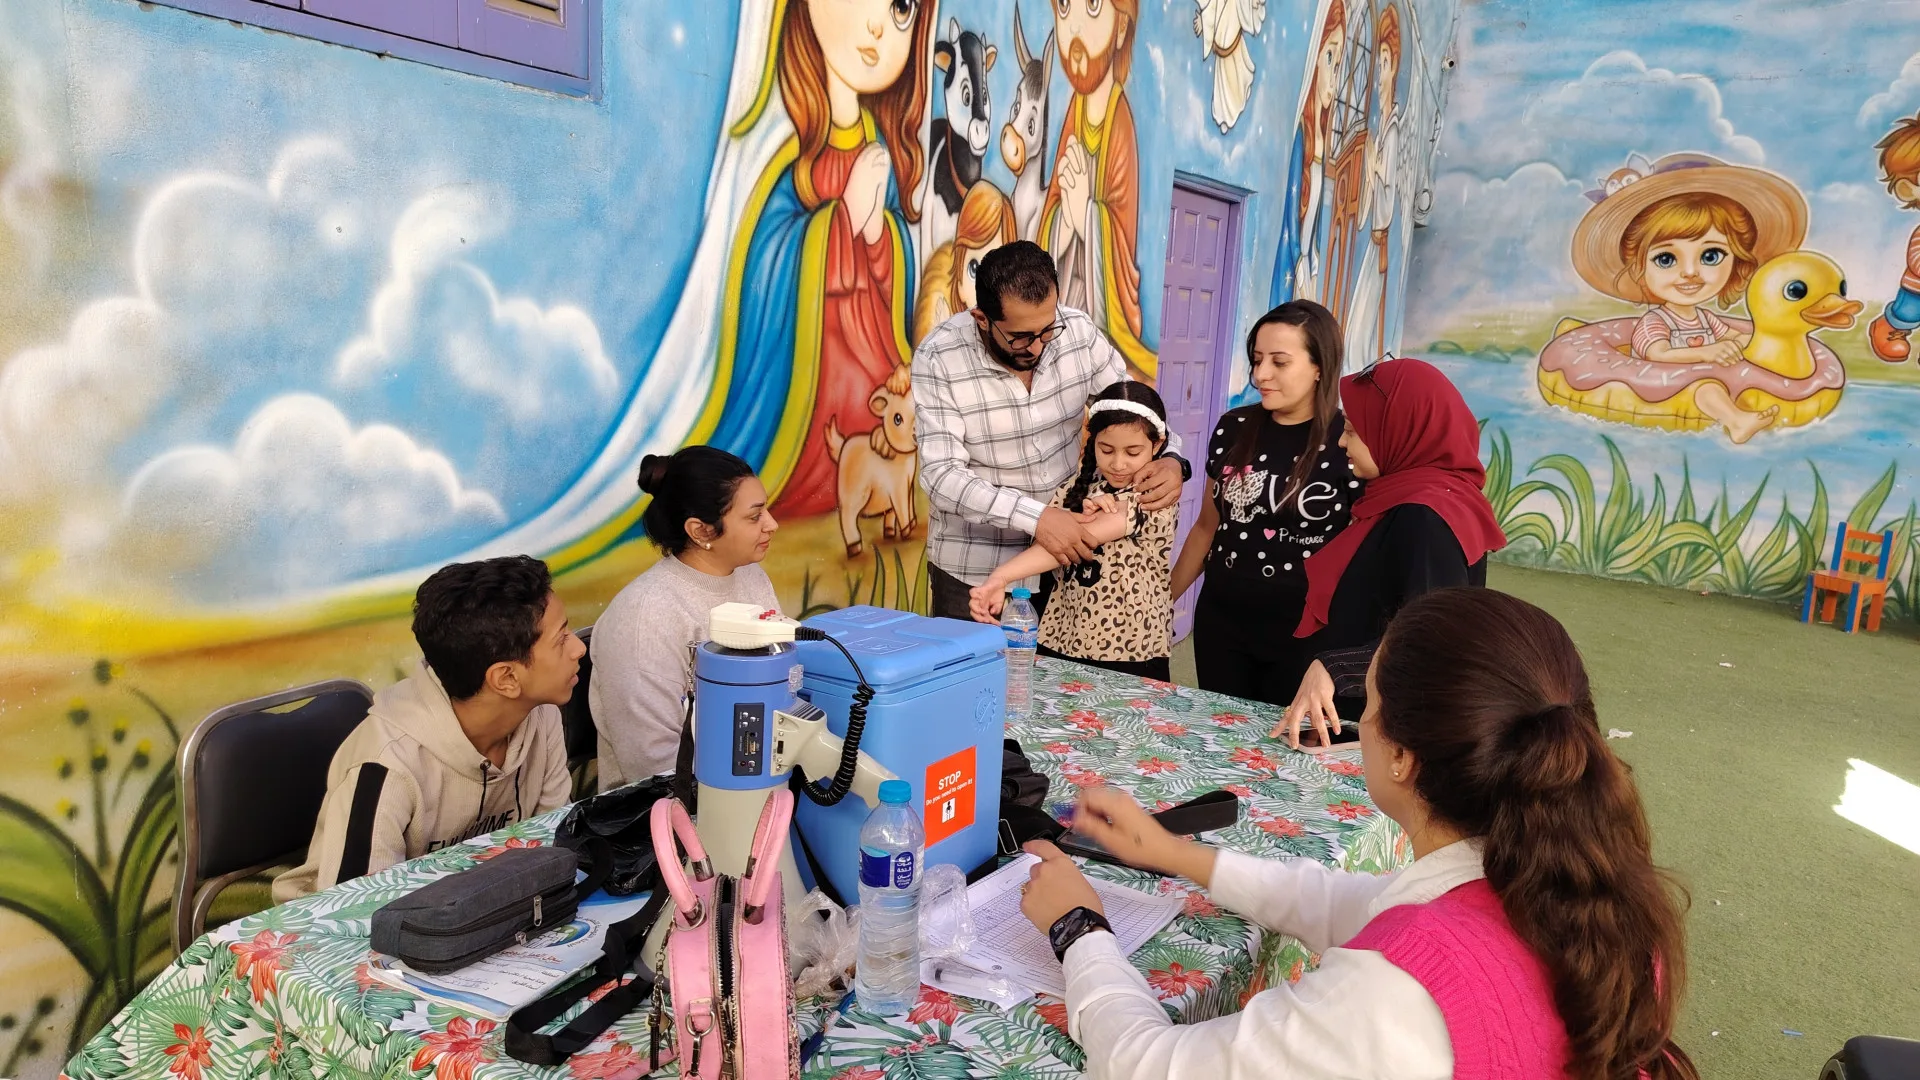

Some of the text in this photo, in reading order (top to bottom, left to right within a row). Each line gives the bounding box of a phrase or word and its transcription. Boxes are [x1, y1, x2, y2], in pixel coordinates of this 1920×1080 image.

[1279, 527, 1325, 546] Princess
[938, 770, 961, 790] STOP
[925, 798, 933, 806] Do
[932, 794, 941, 804] you
[941, 788, 952, 798] need
[956, 781, 967, 791] open
